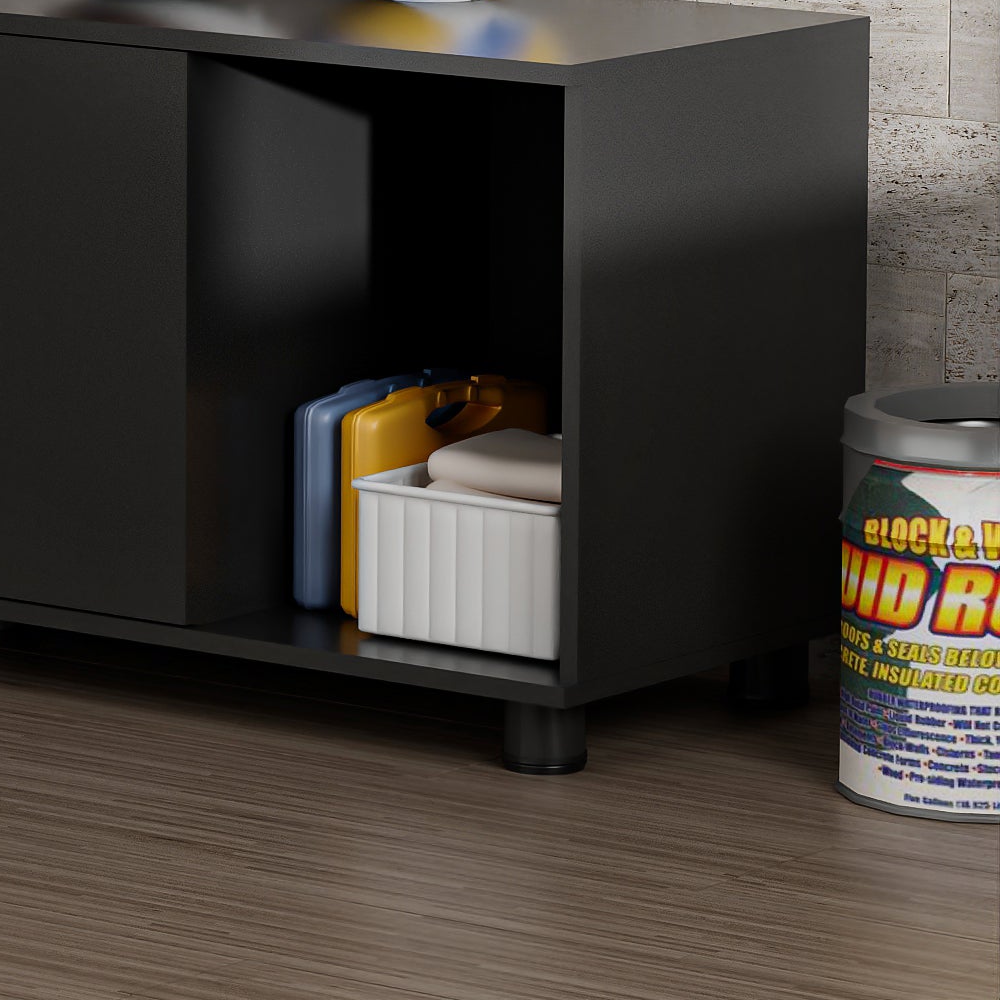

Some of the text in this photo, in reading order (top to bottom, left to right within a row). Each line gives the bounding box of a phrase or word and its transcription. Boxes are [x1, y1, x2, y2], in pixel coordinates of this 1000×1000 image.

[864, 515, 950, 558] BLOCK
[953, 525, 978, 560] &
[929, 562, 1000, 638] R
[841, 620, 871, 650] OOFS
[887, 638, 942, 665] SEALS
[944, 648, 1000, 668] BELO
[872, 661, 970, 693] INSULATED
